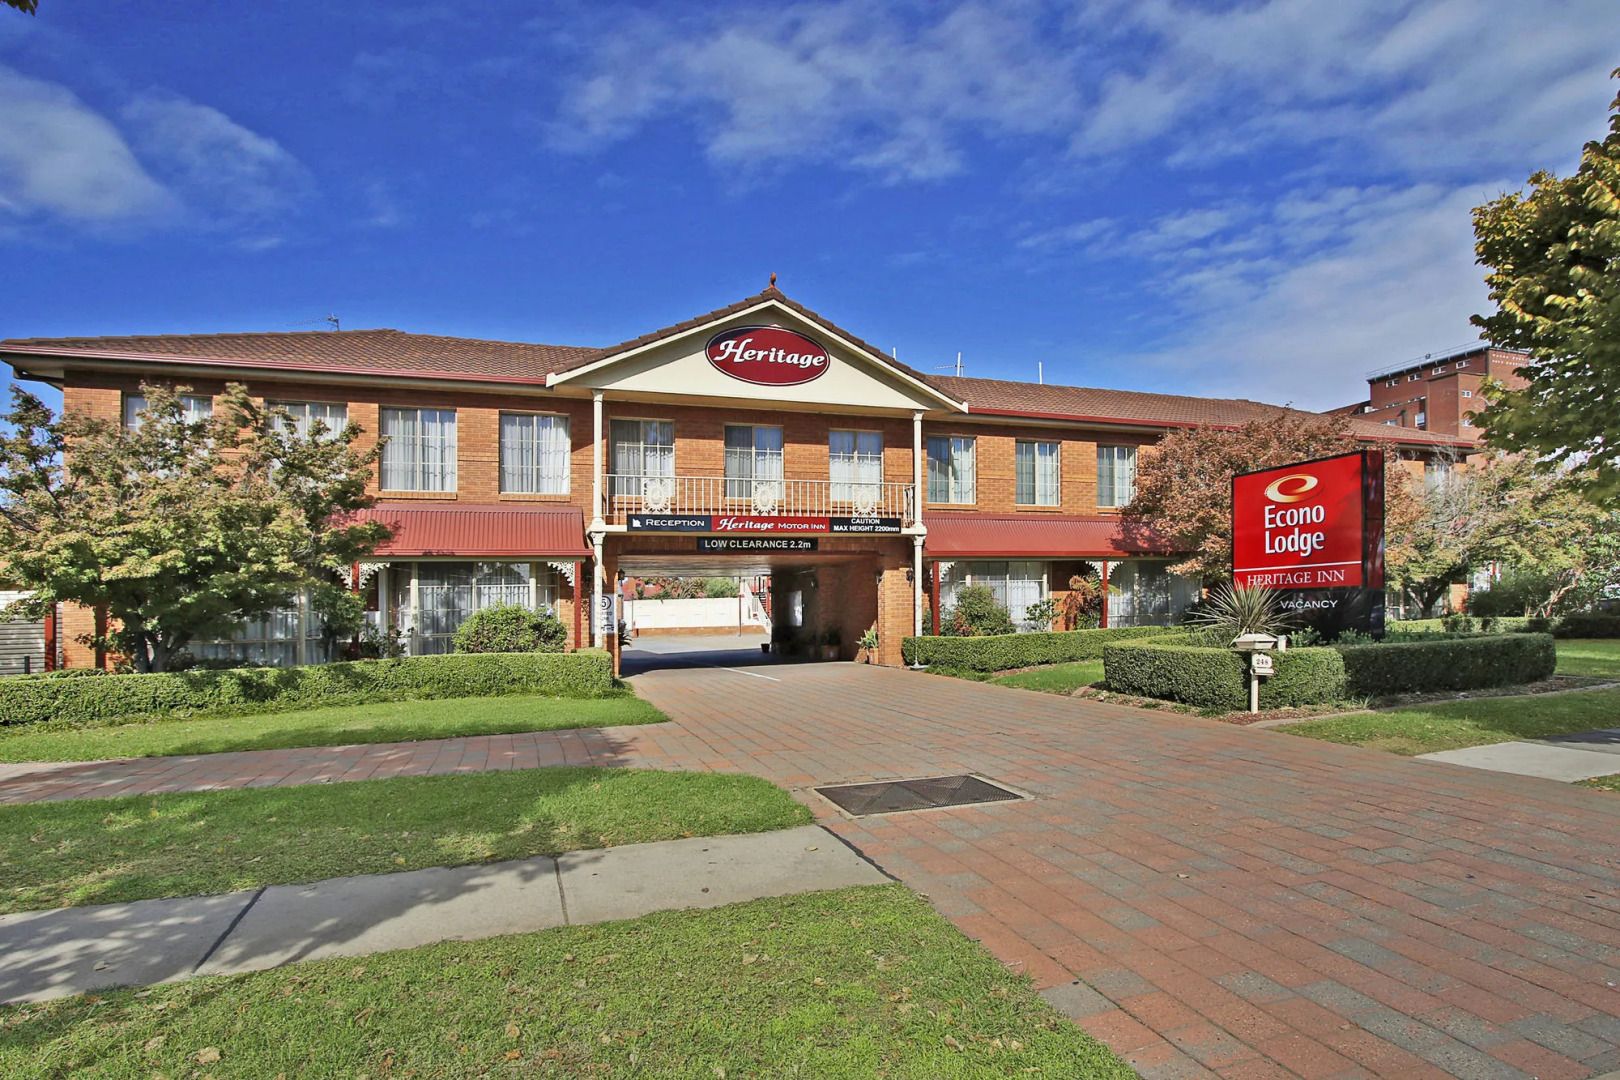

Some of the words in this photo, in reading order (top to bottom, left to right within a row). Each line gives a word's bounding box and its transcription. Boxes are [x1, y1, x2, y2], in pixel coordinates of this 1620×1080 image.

[713, 338, 825, 368] Heritage
[645, 518, 705, 527] RECEPTION
[716, 516, 774, 530] Heritage
[1264, 504, 1325, 529] Econo
[704, 540, 727, 548] LOW
[729, 540, 788, 548] CLEARANCE
[790, 540, 812, 548] 2.2m
[1265, 527, 1325, 557] Lodge
[1247, 572, 1312, 586] HERITAGE
[1317, 570, 1346, 583] INN
[1280, 600, 1338, 609] VACANCY
